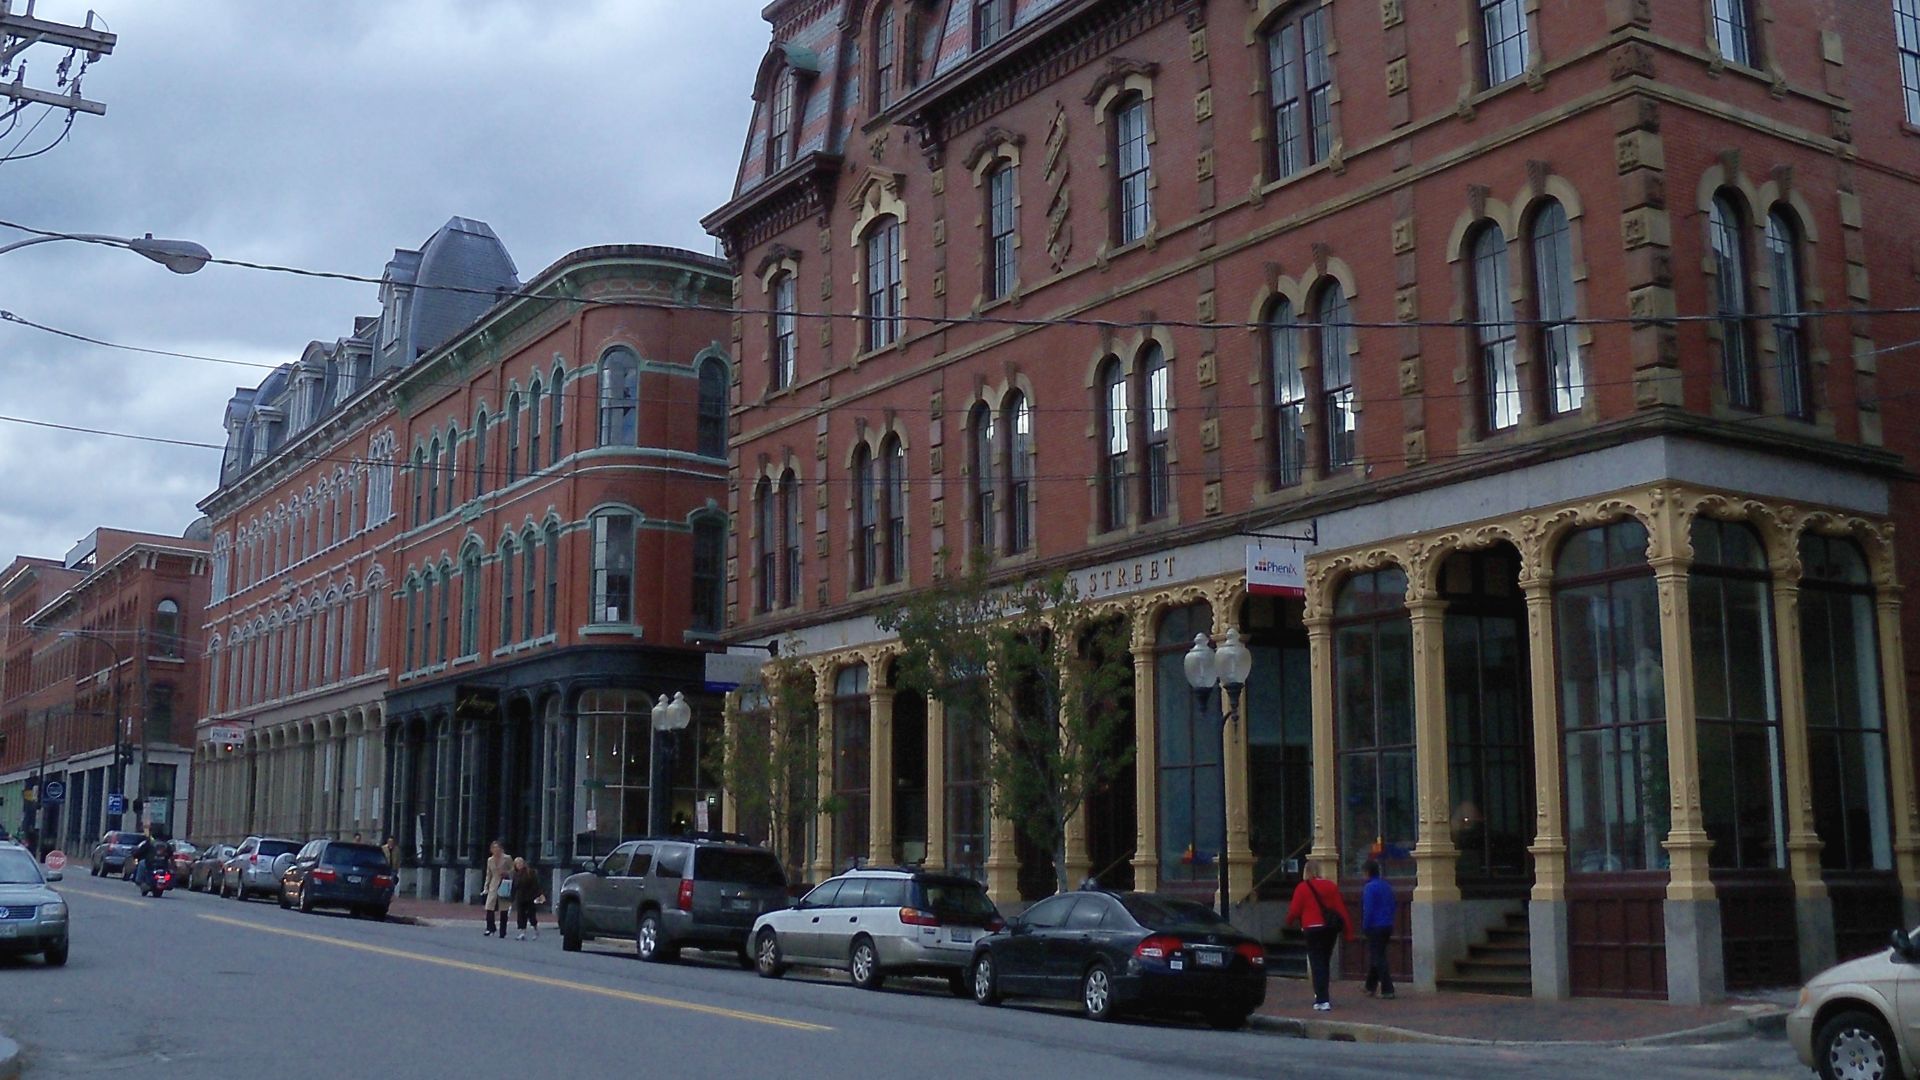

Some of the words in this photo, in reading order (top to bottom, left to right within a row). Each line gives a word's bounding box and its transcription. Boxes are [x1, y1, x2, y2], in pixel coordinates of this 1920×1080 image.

[1089, 556, 1175, 592] STREET
[1267, 561, 1298, 575] Phenix
[47, 856, 65, 865] STOP
